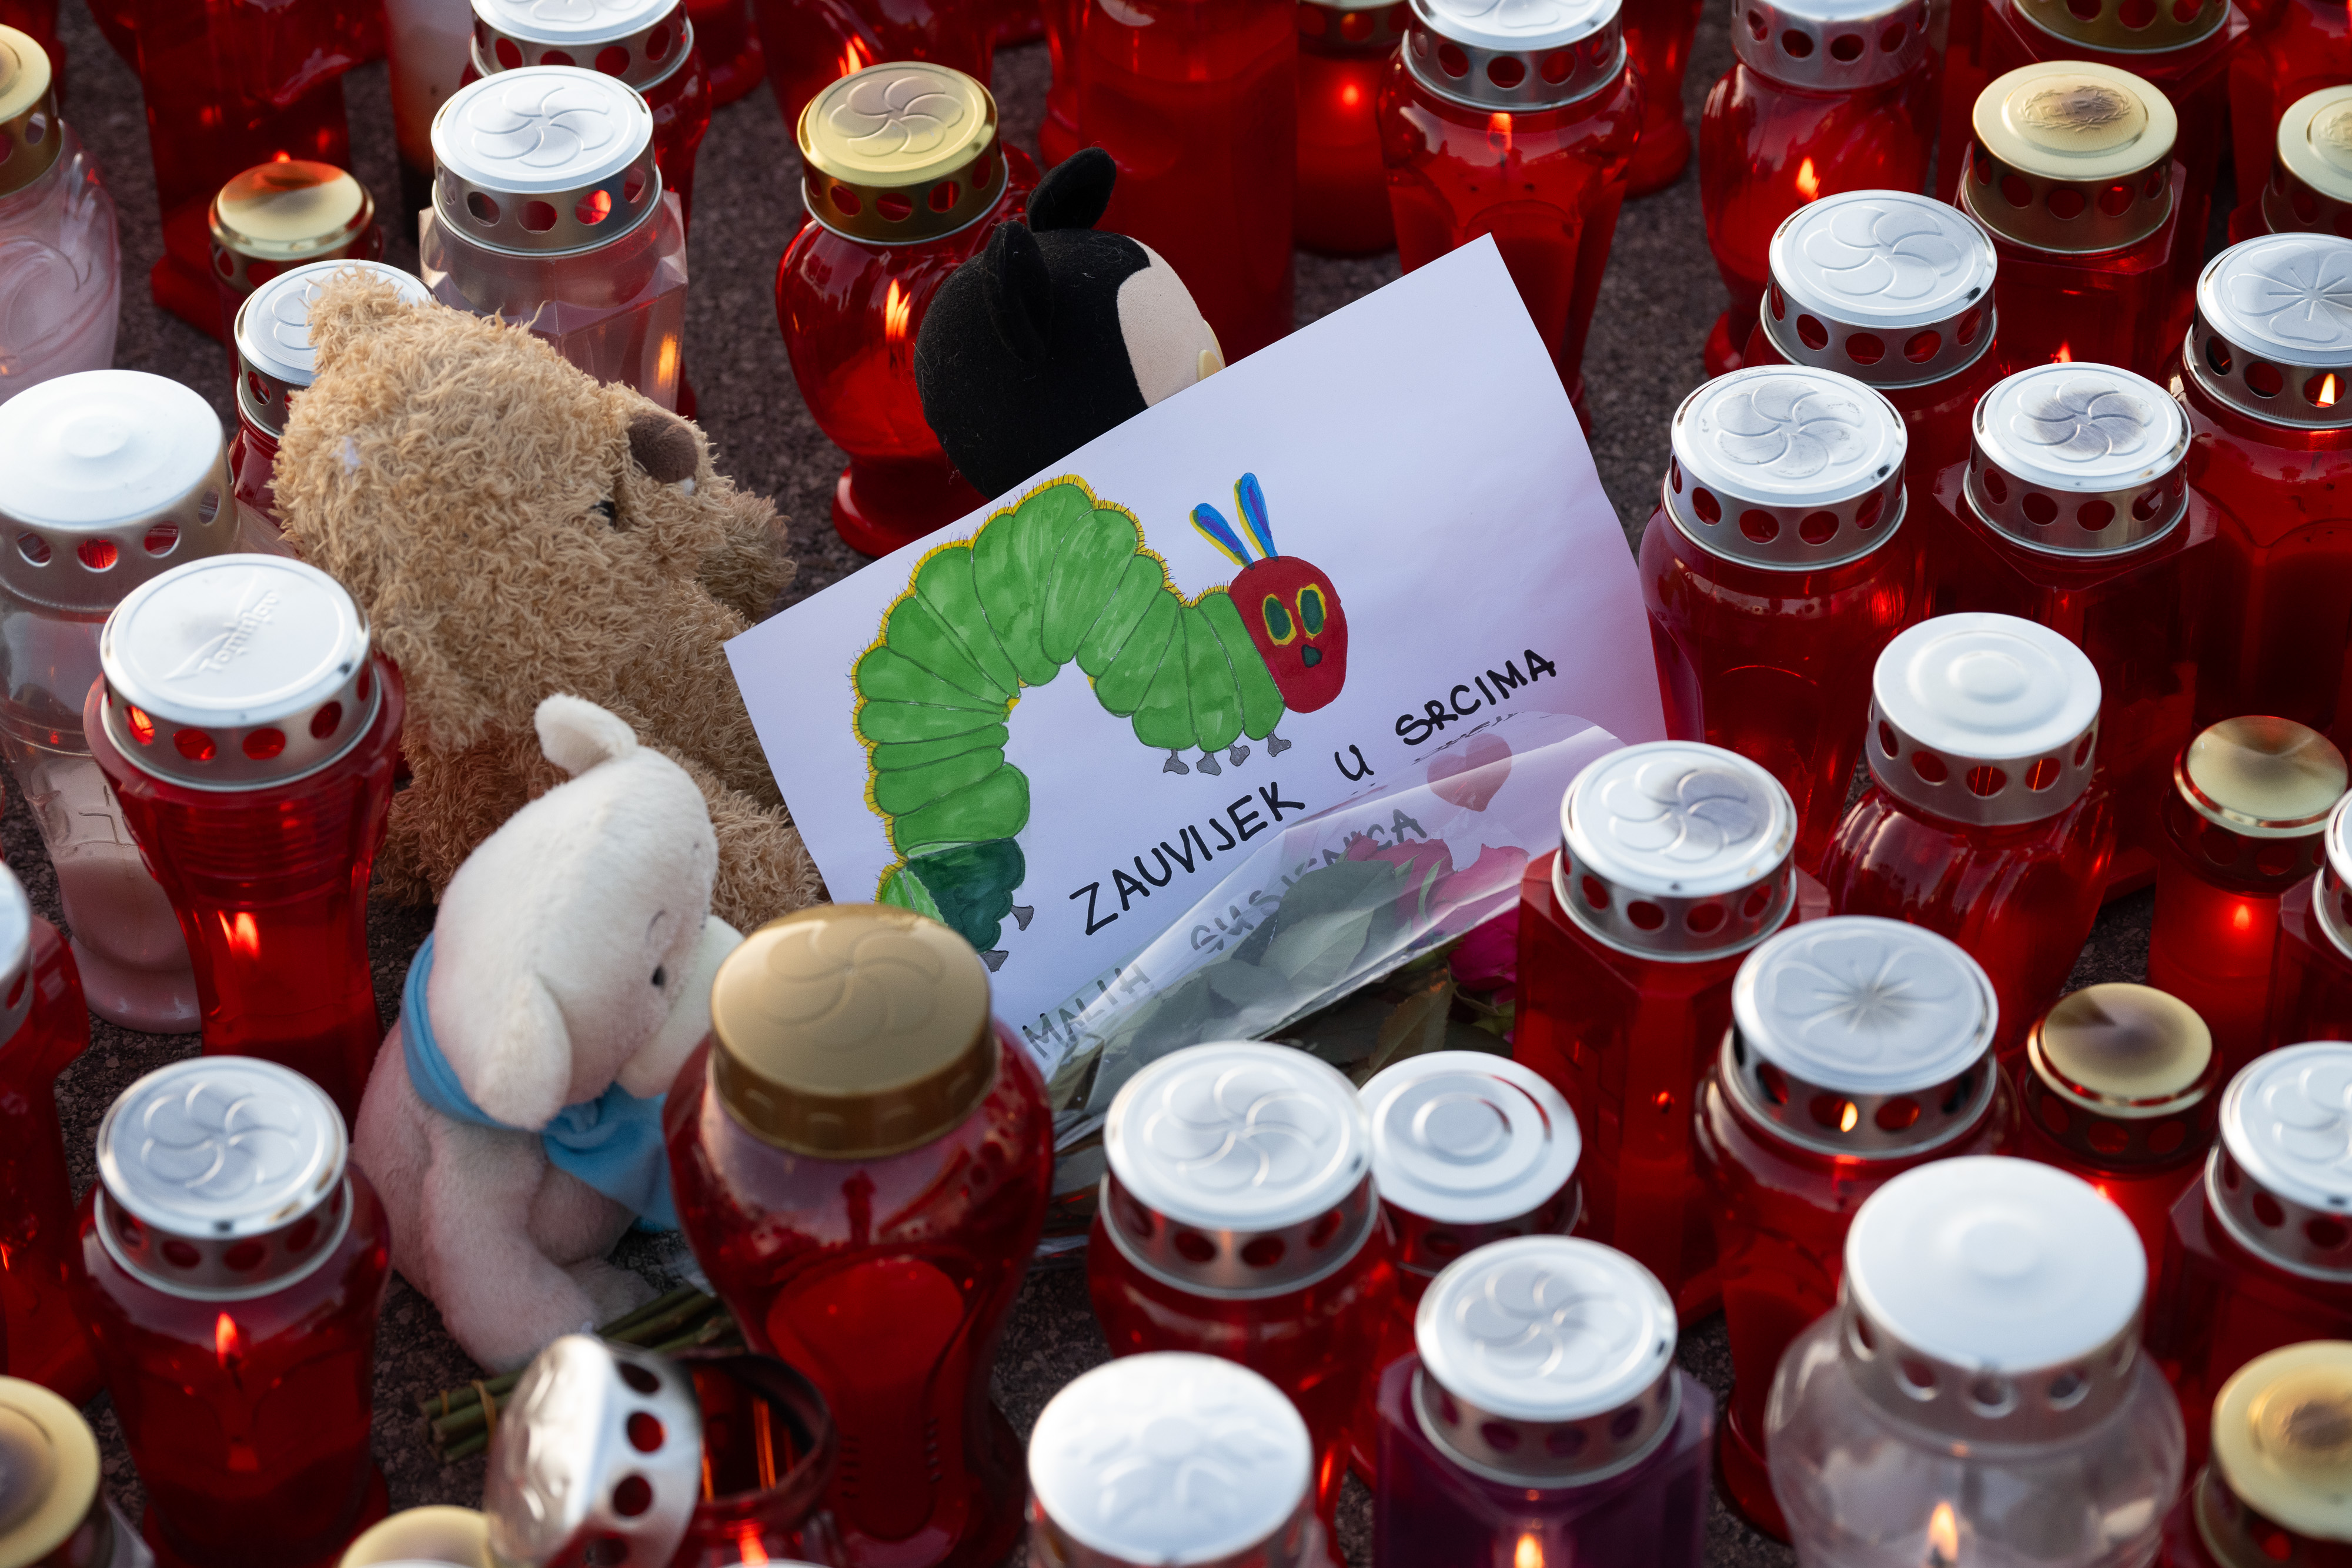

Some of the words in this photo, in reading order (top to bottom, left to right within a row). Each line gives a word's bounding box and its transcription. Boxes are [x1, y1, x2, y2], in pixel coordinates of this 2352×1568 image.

[1069, 781, 1305, 936] ZAUVIJEK
[1395, 649, 1556, 745] SRCIMA
[1022, 962, 1155, 1061] MALIH
